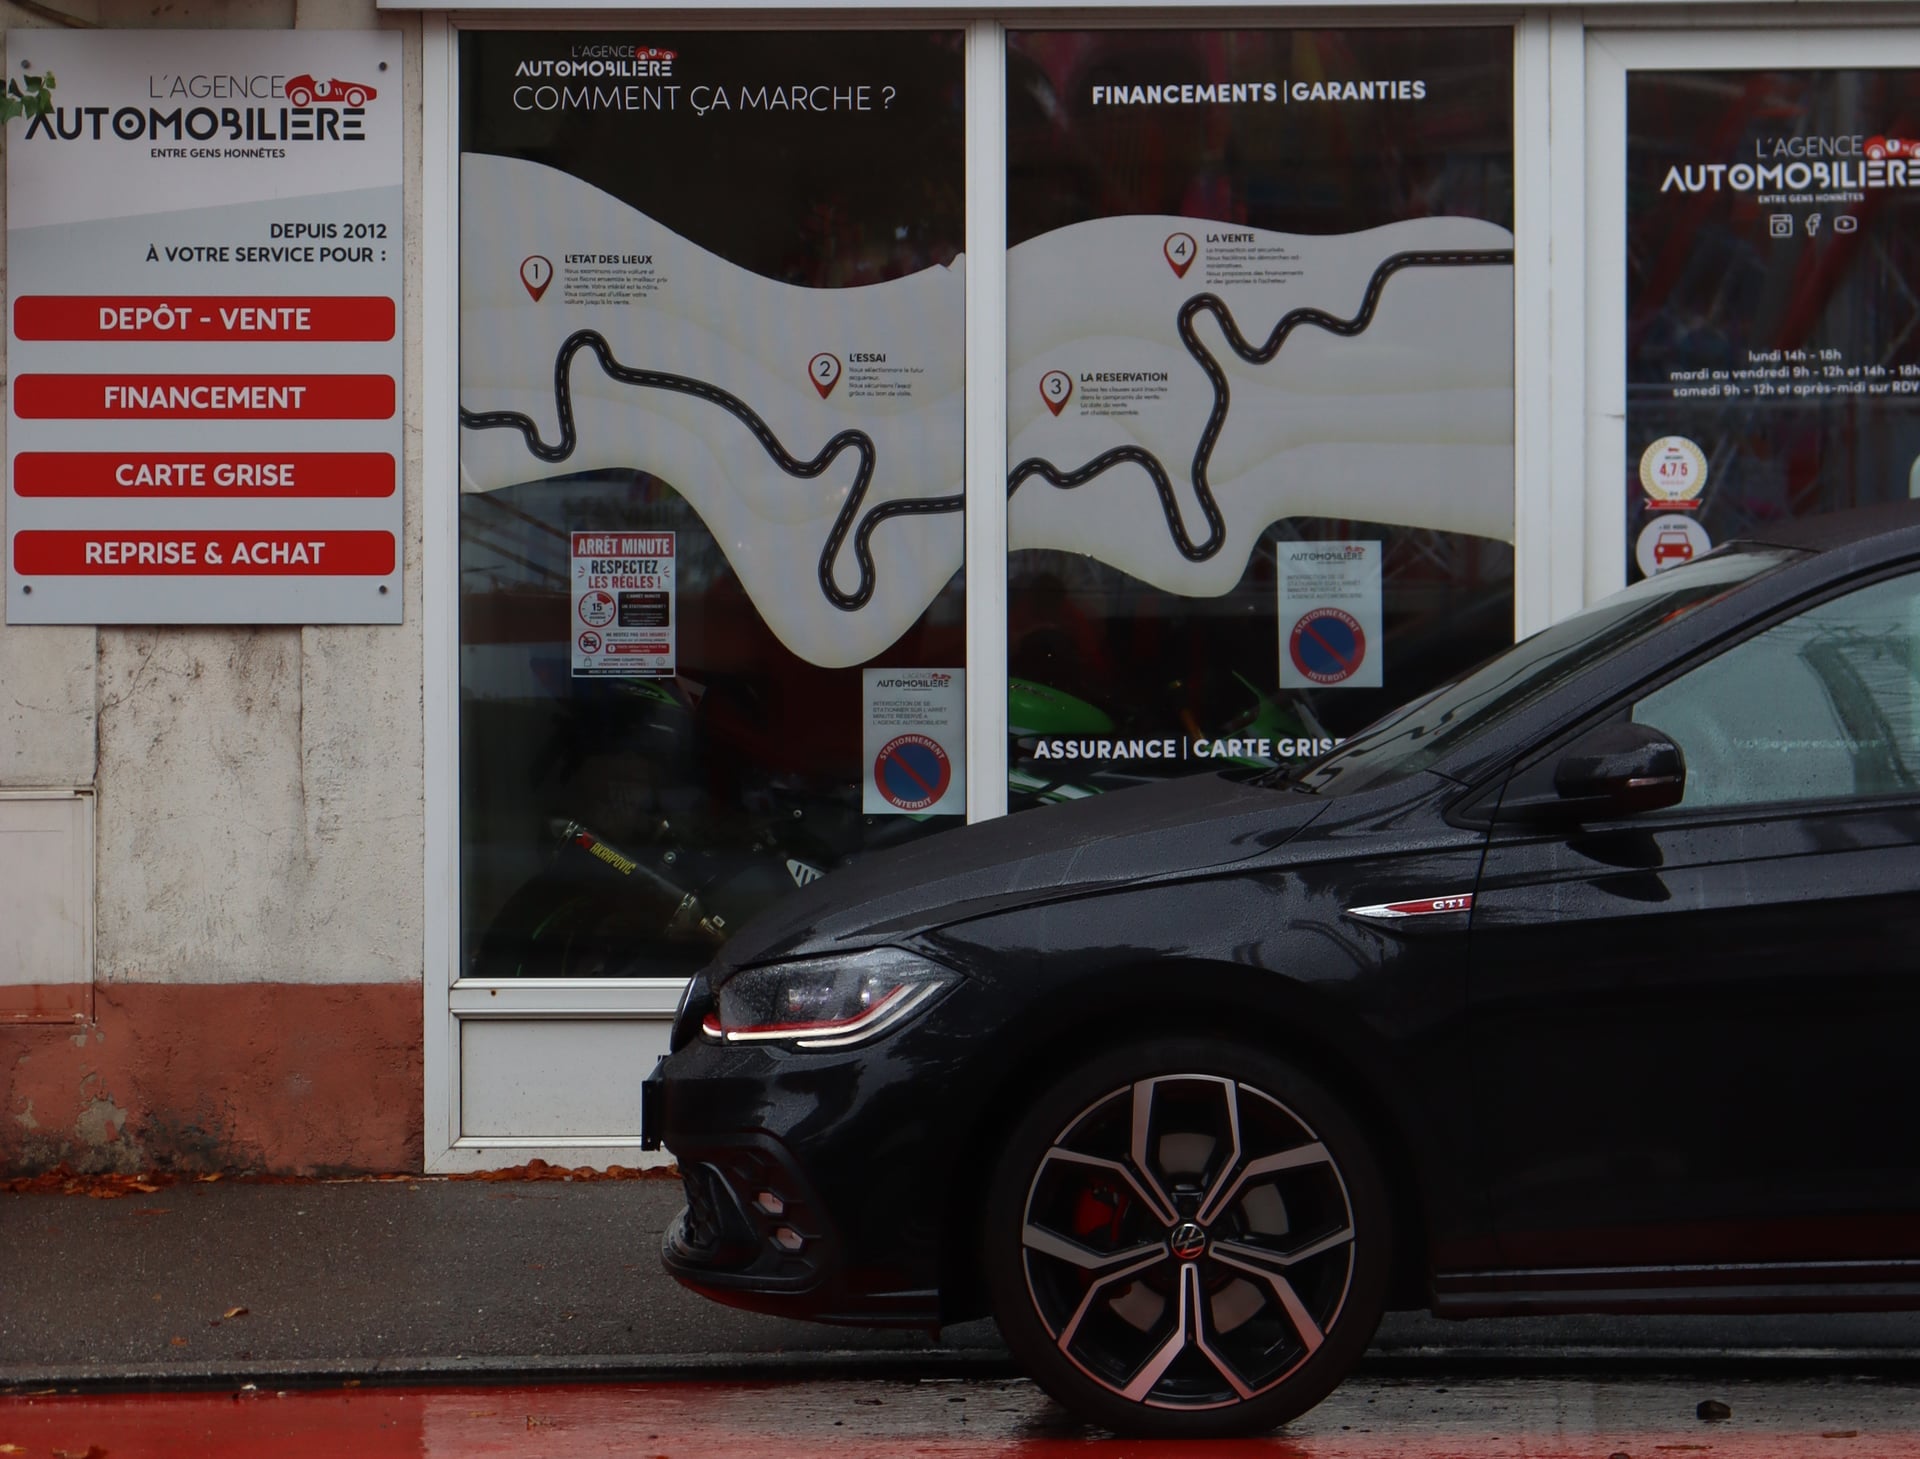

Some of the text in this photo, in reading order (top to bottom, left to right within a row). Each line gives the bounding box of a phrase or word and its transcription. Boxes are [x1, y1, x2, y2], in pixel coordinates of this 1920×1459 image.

[571, 45, 636, 58] L'AGENCE
[149, 75, 285, 99] L'AGENCE
[1092, 80, 1427, 106] FINANCEMENTS GARANTIES
[513, 85, 897, 117] COMMENT ÇA MARCHE ?
[150, 147, 286, 158] ENTRE GENS HONNÊTES
[1755, 135, 1864, 158] L'AGENCE
[1758, 194, 1787, 204] ENTRE
[1789, 194, 1813, 203] GENS
[269, 223, 387, 239] DEPUIS 2012
[1206, 233, 1255, 243] LA VENTE
[146, 243, 160, 263] À
[165, 247, 230, 263] VOTRE
[235, 247, 315, 263] SERVICE
[320, 247, 374, 263] POUR
[1174, 241, 1187, 256] 4
[564, 254, 653, 265] L'ETAT DES LIEUX
[533, 263, 540, 281] 1
[98, 303, 192, 331] DEPÔT
[219, 307, 311, 331] VENTE
[849, 352, 886, 363] L'ESSAI
[1748, 348, 1781, 363] lundi
[1783, 348, 1806, 363] 14h
[1820, 348, 1842, 363] 18h
[819, 360, 831, 377] 2
[1670, 368, 1710, 381] mardi
[1712, 369, 1729, 380] au
[1732, 366, 1790, 380] vendredi
[1792, 366, 1810, 379] 9h
[1823, 365, 1845, 378] 12h
[1846, 366, 1860, 378] et
[1863, 365, 1886, 377] 14h
[1080, 372, 1168, 382] LA RESERVATION
[1051, 379, 1063, 396] 3
[1672, 385, 1721, 398] samedi
[1723, 384, 1740, 397] 9h
[1753, 383, 1775, 396] 12h
[1777, 383, 1790, 395] et
[1793, 381, 1866, 398] après-midi
[1868, 384, 1889, 393] sur
[1892, 381, 1920, 393] RDV
[104, 386, 306, 409] FINANCEMENT
[115, 463, 295, 487] CARTE GRISE
[84, 541, 326, 565] REPRISE & ACHAT
[578, 535, 670, 555] ARRÊT MINUTE
[591, 559, 659, 575] RESPECTEZ
[588, 575, 609, 589] LES
[592, 603, 602, 611] 15
[1295, 608, 1360, 634] STATIONNEMENT
[1307, 670, 1347, 682] INTERDIT
[880, 735, 945, 760] STATIONNEMENT
[1034, 739, 1176, 760] ASSURANCE
[1193, 738, 1271, 758] CARTE
[892, 796, 932, 808] INTERDIT
[1432, 898, 1465, 910] GTI
